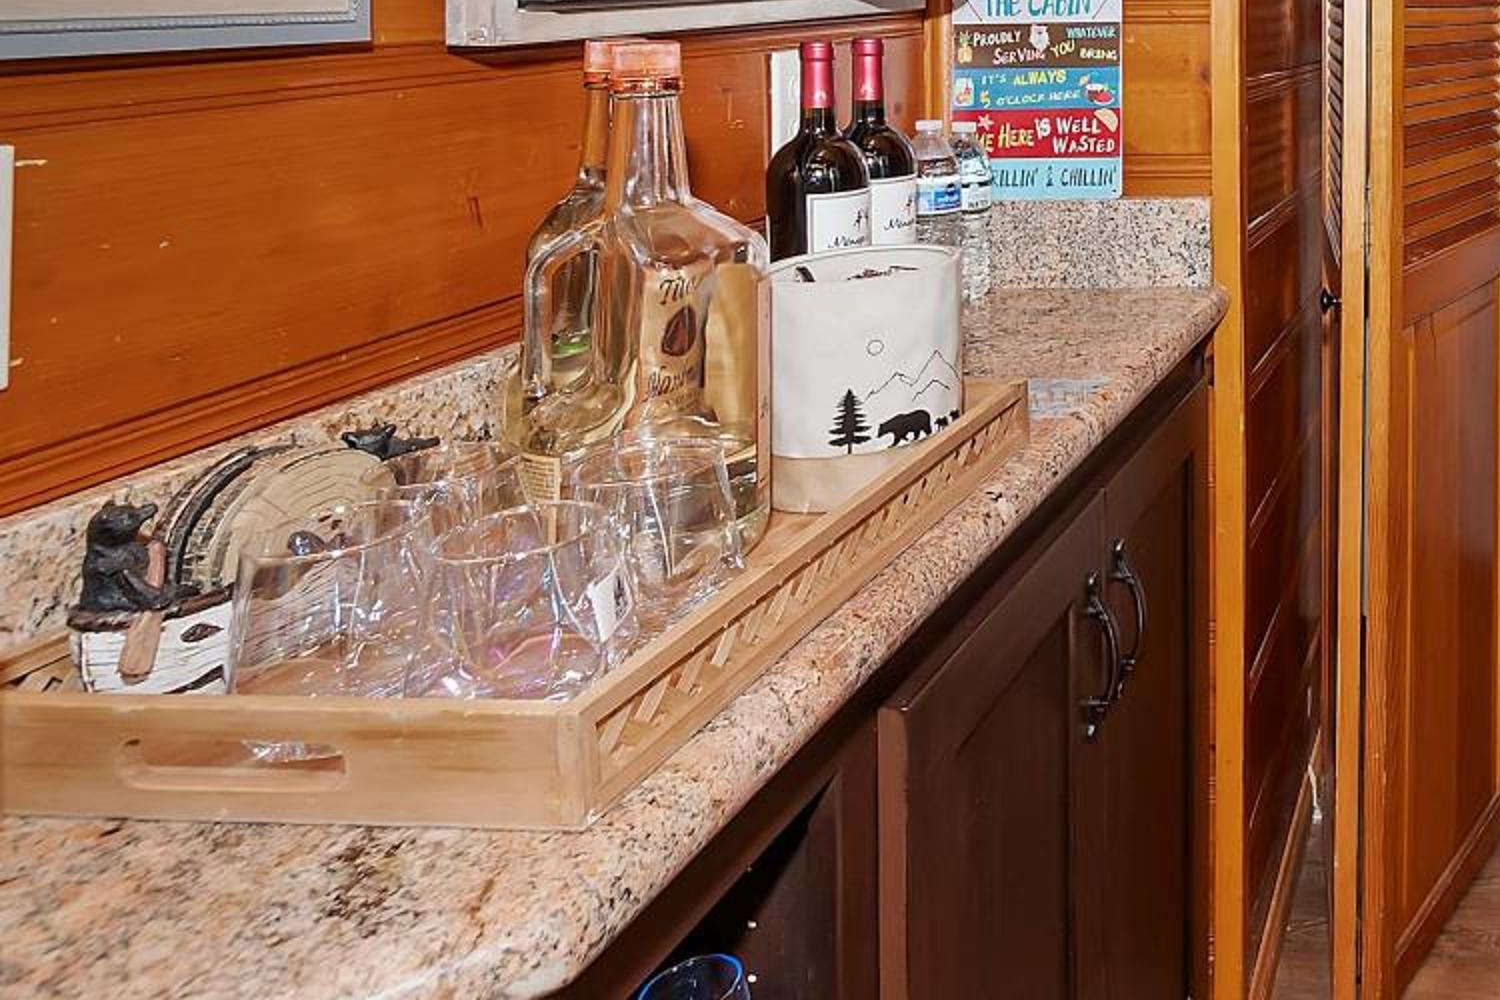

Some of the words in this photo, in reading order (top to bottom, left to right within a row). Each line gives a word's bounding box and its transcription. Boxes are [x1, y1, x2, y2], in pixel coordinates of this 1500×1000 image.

[973, 30, 1022, 48] PROUDLY
[1050, 39, 1076, 58] YOU
[1013, 69, 1067, 86] ALWAYS
[979, 90, 991, 109] 5
[998, 121, 1036, 149] HERE
[1055, 116, 1103, 136] WELL
[1052, 134, 1116, 155] WASTED
[991, 167, 1040, 188] RILLIN'
[1060, 164, 1118, 188] CHILLIN'
